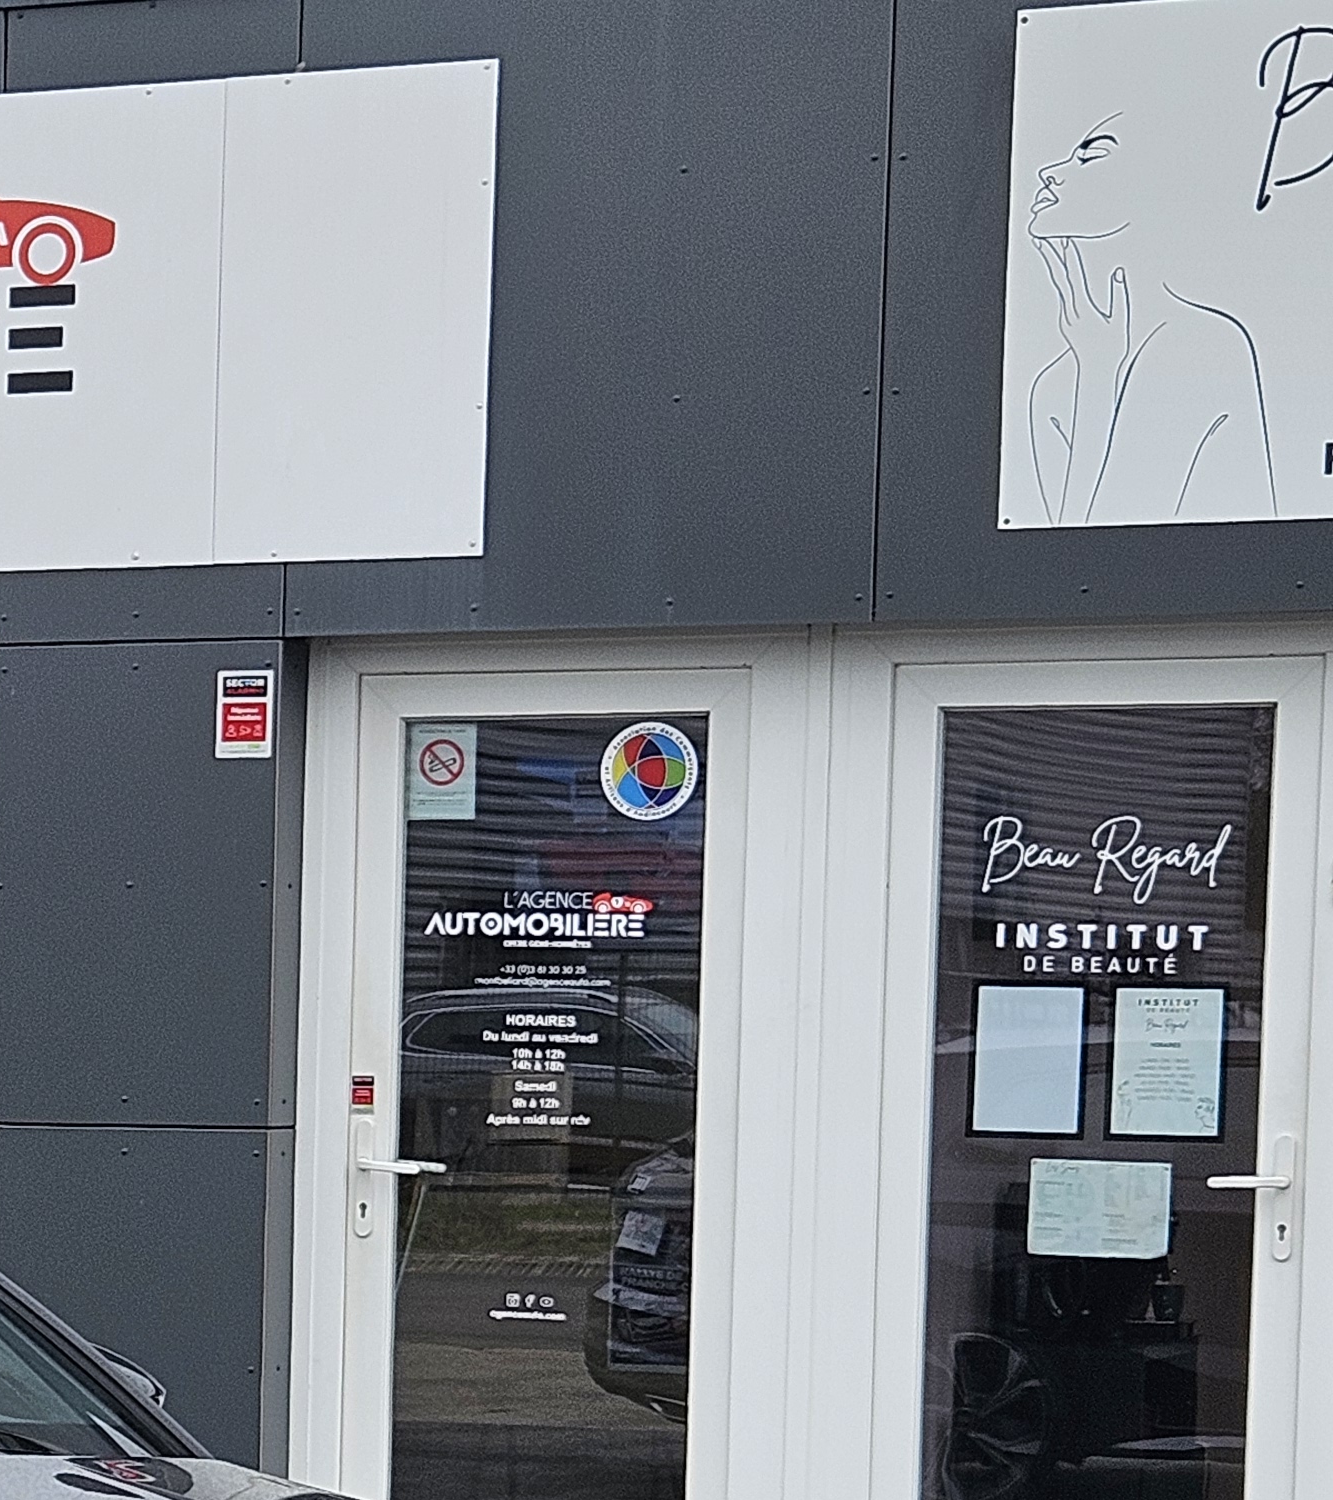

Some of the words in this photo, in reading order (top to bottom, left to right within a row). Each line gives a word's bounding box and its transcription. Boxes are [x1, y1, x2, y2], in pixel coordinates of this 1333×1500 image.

[980, 814, 1081, 894] Beau
[1091, 814, 1233, 905] Regard
[503, 891, 593, 909] L'AGENCE
[424, 912, 645, 938] AUTOMOBILIERE
[995, 921, 1209, 952] INSTITUT
[1023, 955, 1055, 974] DE
[1071, 953, 1177, 975] BEAUTÉ
[1138, 998, 1200, 1007] INSTITUT
[505, 1014, 577, 1028] HORAIRES
[482, 1030, 499, 1041] Du
[500, 1030, 530, 1042] lundi
[512, 1047, 533, 1059] 10h
[544, 1048, 567, 1060] 12h
[511, 1060, 532, 1070] 14h
[514, 1080, 558, 1092] Samedi
[539, 1098, 560, 1109] 12h
[485, 1113, 521, 1127] Après
[522, 1114, 548, 1125] midi
[549, 1116, 569, 1126] sur
